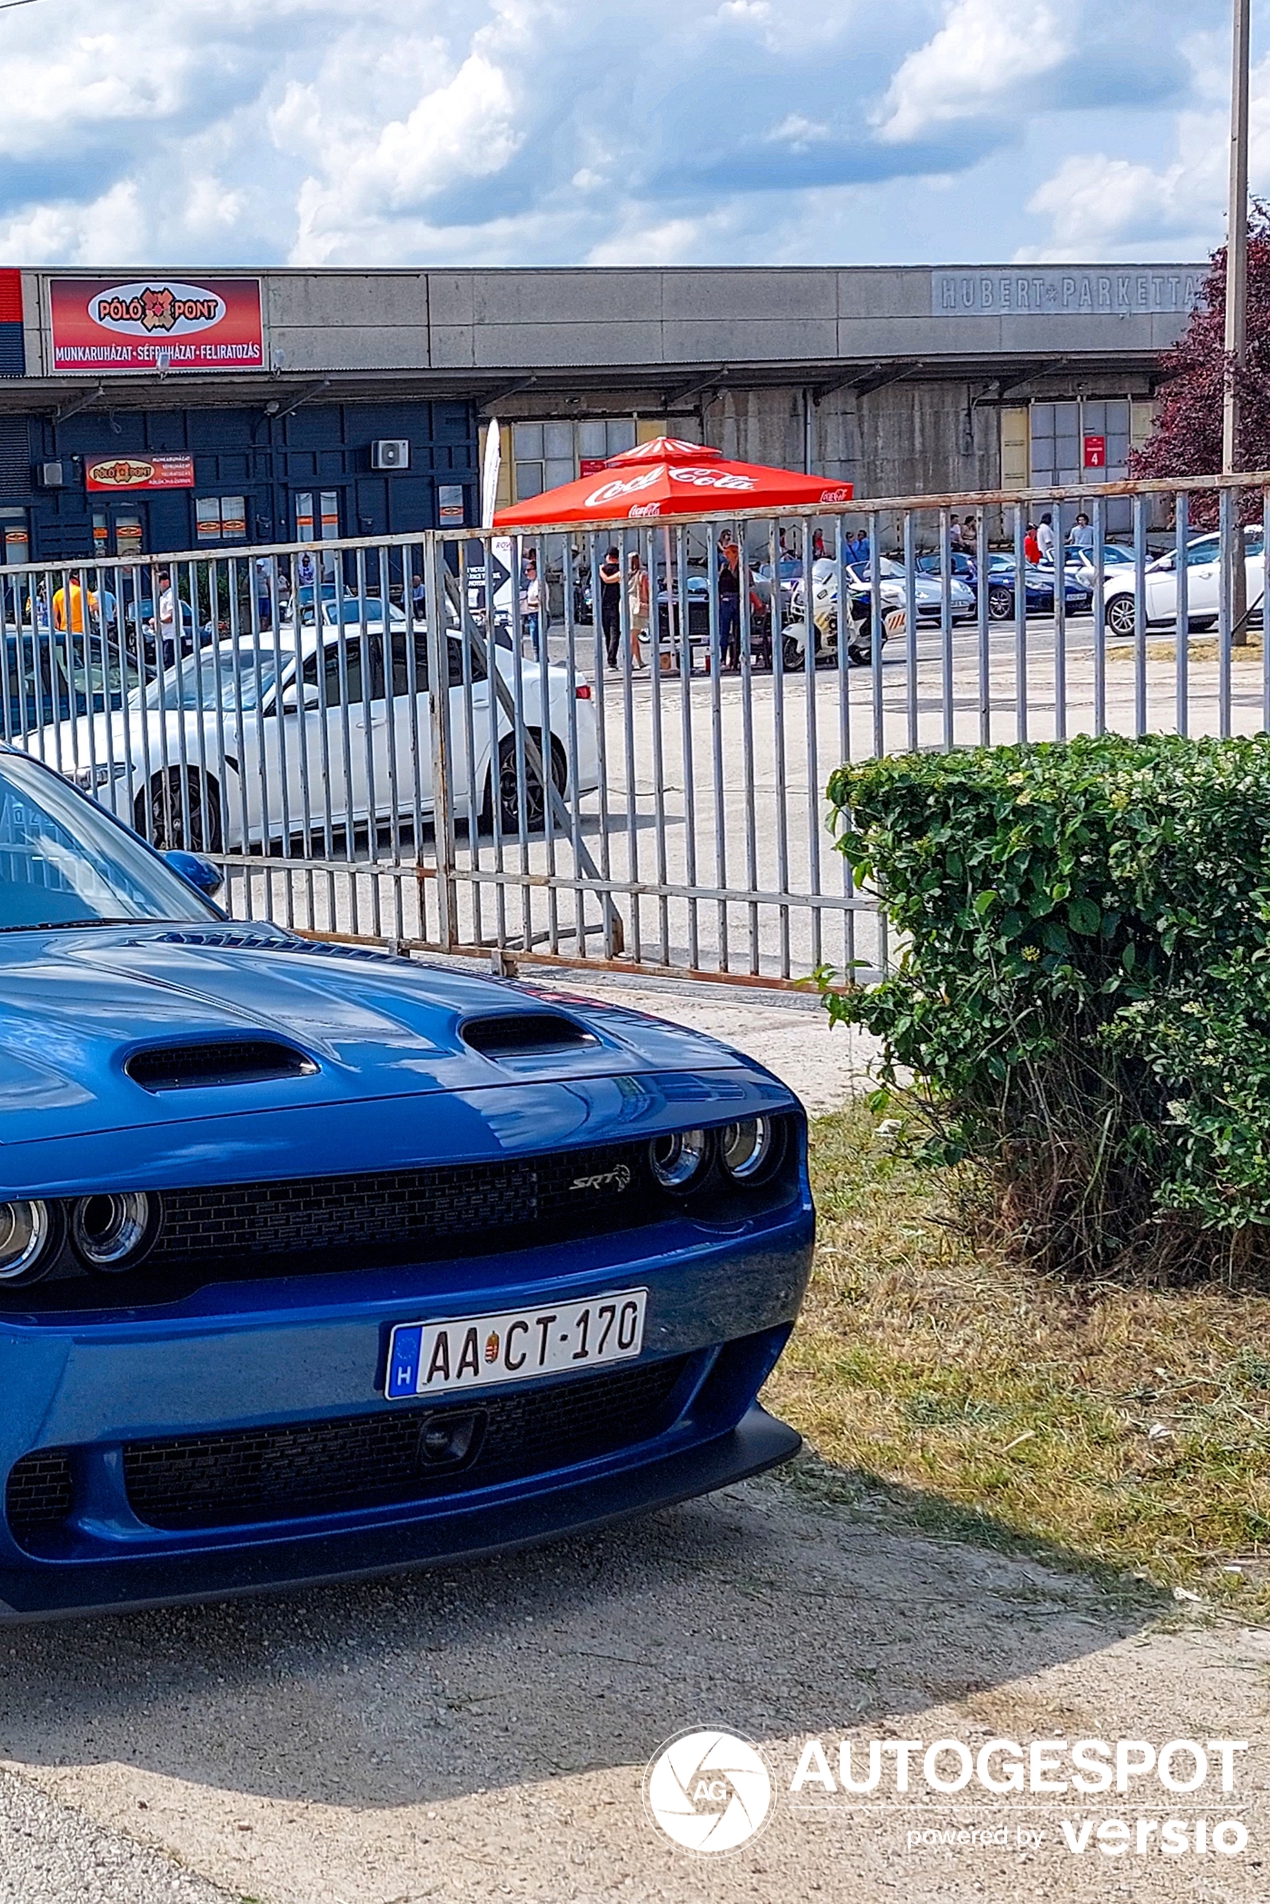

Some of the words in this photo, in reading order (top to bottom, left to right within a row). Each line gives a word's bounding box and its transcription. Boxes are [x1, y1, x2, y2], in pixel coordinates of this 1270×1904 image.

[942, 278, 1044, 308] HUBERT
[99, 297, 142, 321] PÓLÓ
[174, 299, 218, 320] PONT
[56, 343, 132, 361] MUNKARUHÁZAT
[201, 341, 260, 359] FELIRATOZÁS
[1091, 453, 1098, 465] 4
[584, 465, 665, 507] Coca
[668, 466, 757, 490] Cola
[569, 1171, 618, 1190] SRT
[427, 1327, 479, 1383] AA
[504, 1301, 637, 1371] CT-170
[397, 1366, 411, 1386] H
